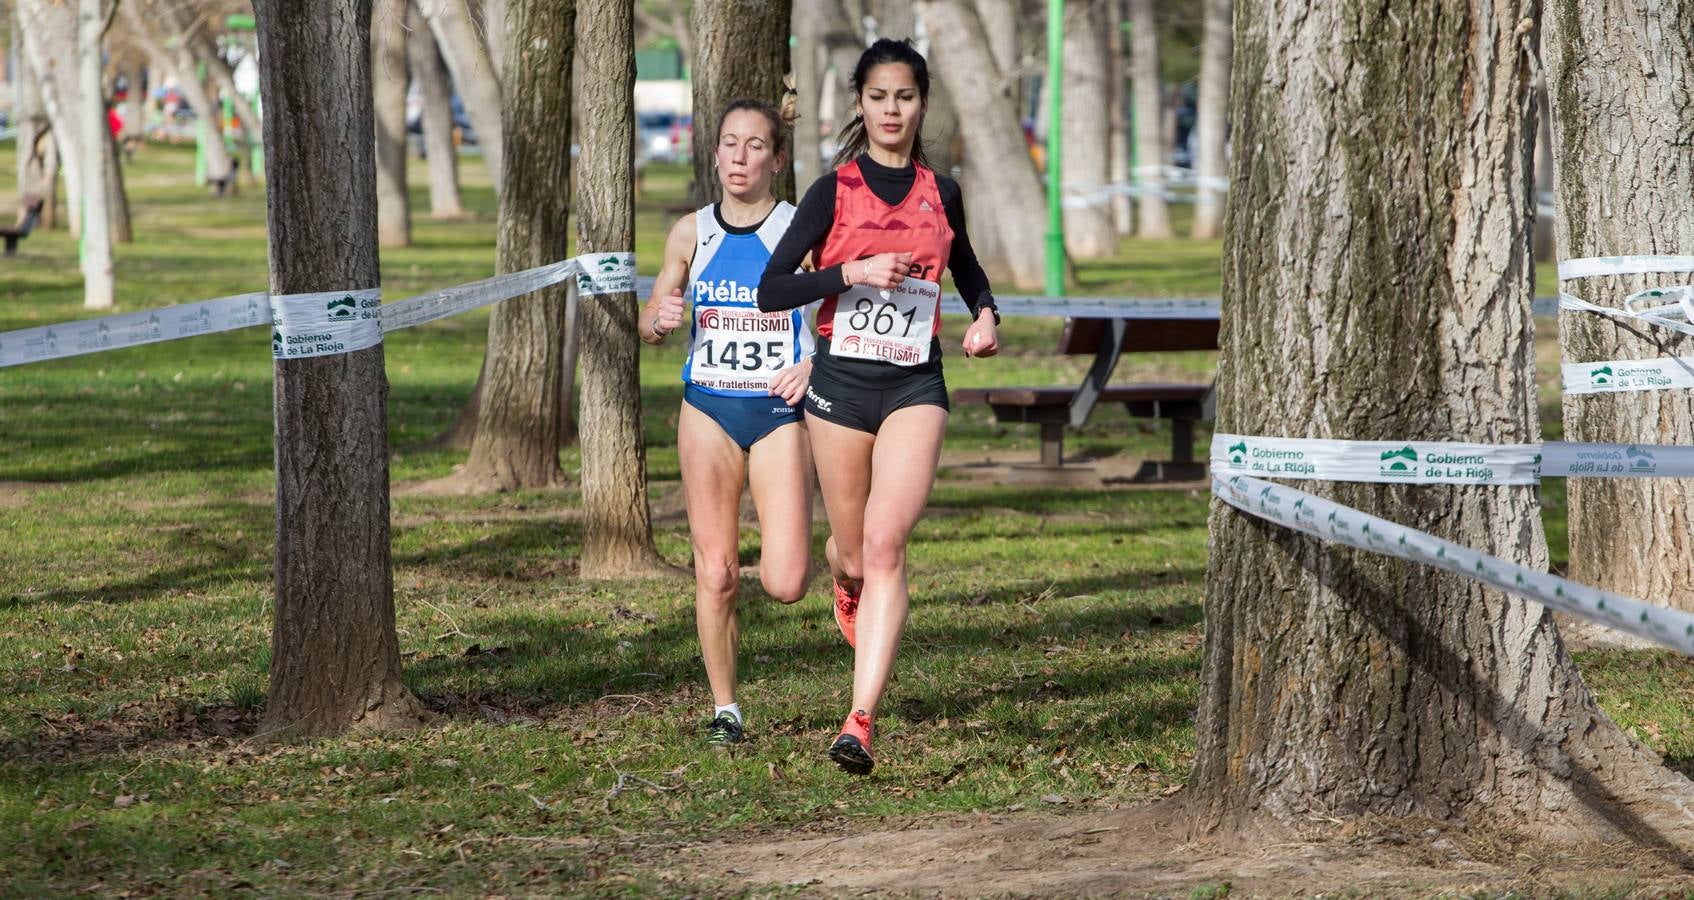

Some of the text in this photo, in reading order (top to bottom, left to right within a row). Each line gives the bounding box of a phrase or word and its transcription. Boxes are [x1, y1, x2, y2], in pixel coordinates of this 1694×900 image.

[896, 284, 906, 292] de
[908, 286, 918, 294] La
[919, 288, 936, 298] Rioja
[361, 310, 371, 319] de
[849, 297, 917, 338] 861
[722, 317, 790, 331] ATLETISMO
[287, 333, 332, 345] Gobierno
[287, 342, 344, 355] de La Rioja
[701, 338, 785, 371] 1435
[1617, 368, 1662, 377] Gobierno
[1618, 376, 1672, 387] de La Rioja
[1252, 447, 1304, 459] Gobierno
[1426, 453, 1484, 464] Gobierno
[1252, 461, 1315, 474] de La Rioja
[1425, 467, 1493, 480] de La Rioja
